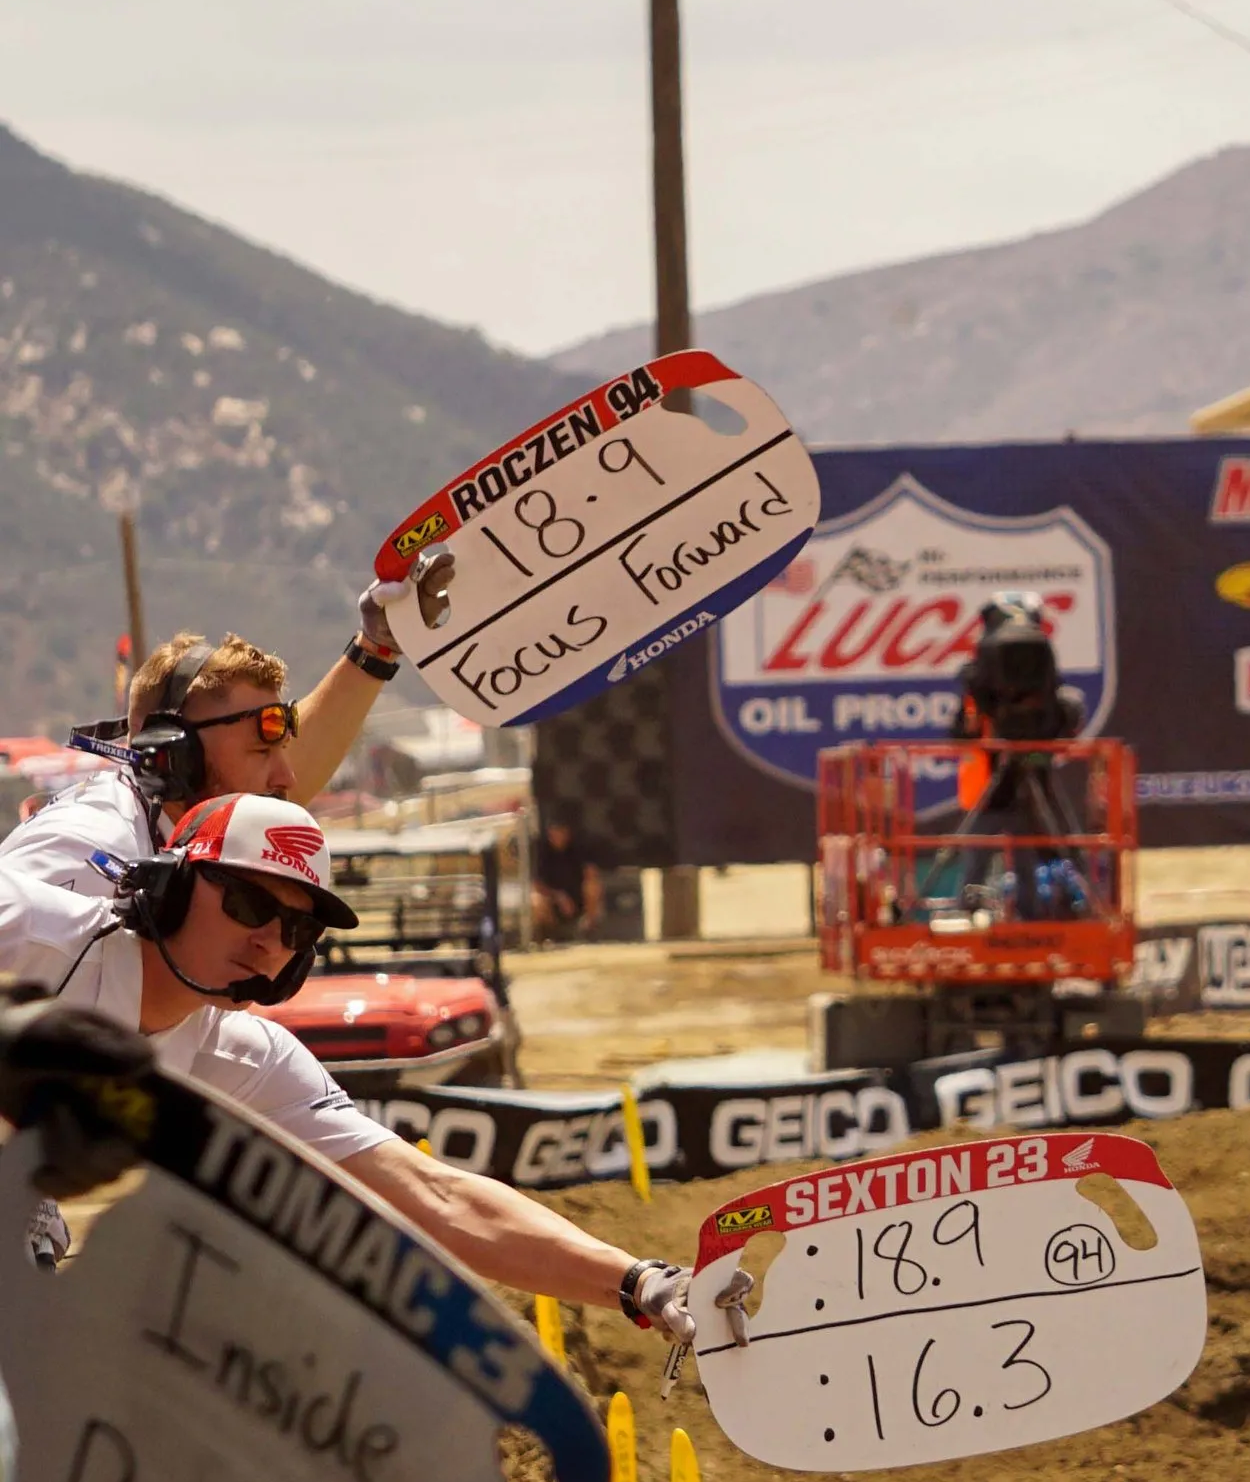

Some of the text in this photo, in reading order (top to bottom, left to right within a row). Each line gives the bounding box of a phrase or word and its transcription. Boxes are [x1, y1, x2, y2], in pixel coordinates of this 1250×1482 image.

[450, 367, 661, 523] ROCZEN 94
[481, 439, 665, 577] 18.9
[451, 471, 793, 710] Focus Forward
[627, 610, 717, 671] HONDA
[90, 740, 137, 763] TROXELL
[737, 695, 822, 735] OIL
[260, 848, 321, 888] HONDA
[709, 1086, 910, 1168] GEICO
[935, 1047, 1194, 1128] GEICO
[785, 1136, 1049, 1227] SEXTON 23
[194, 1107, 546, 1416] TOMAC 3
[1052, 1235, 1103, 1280] 94
